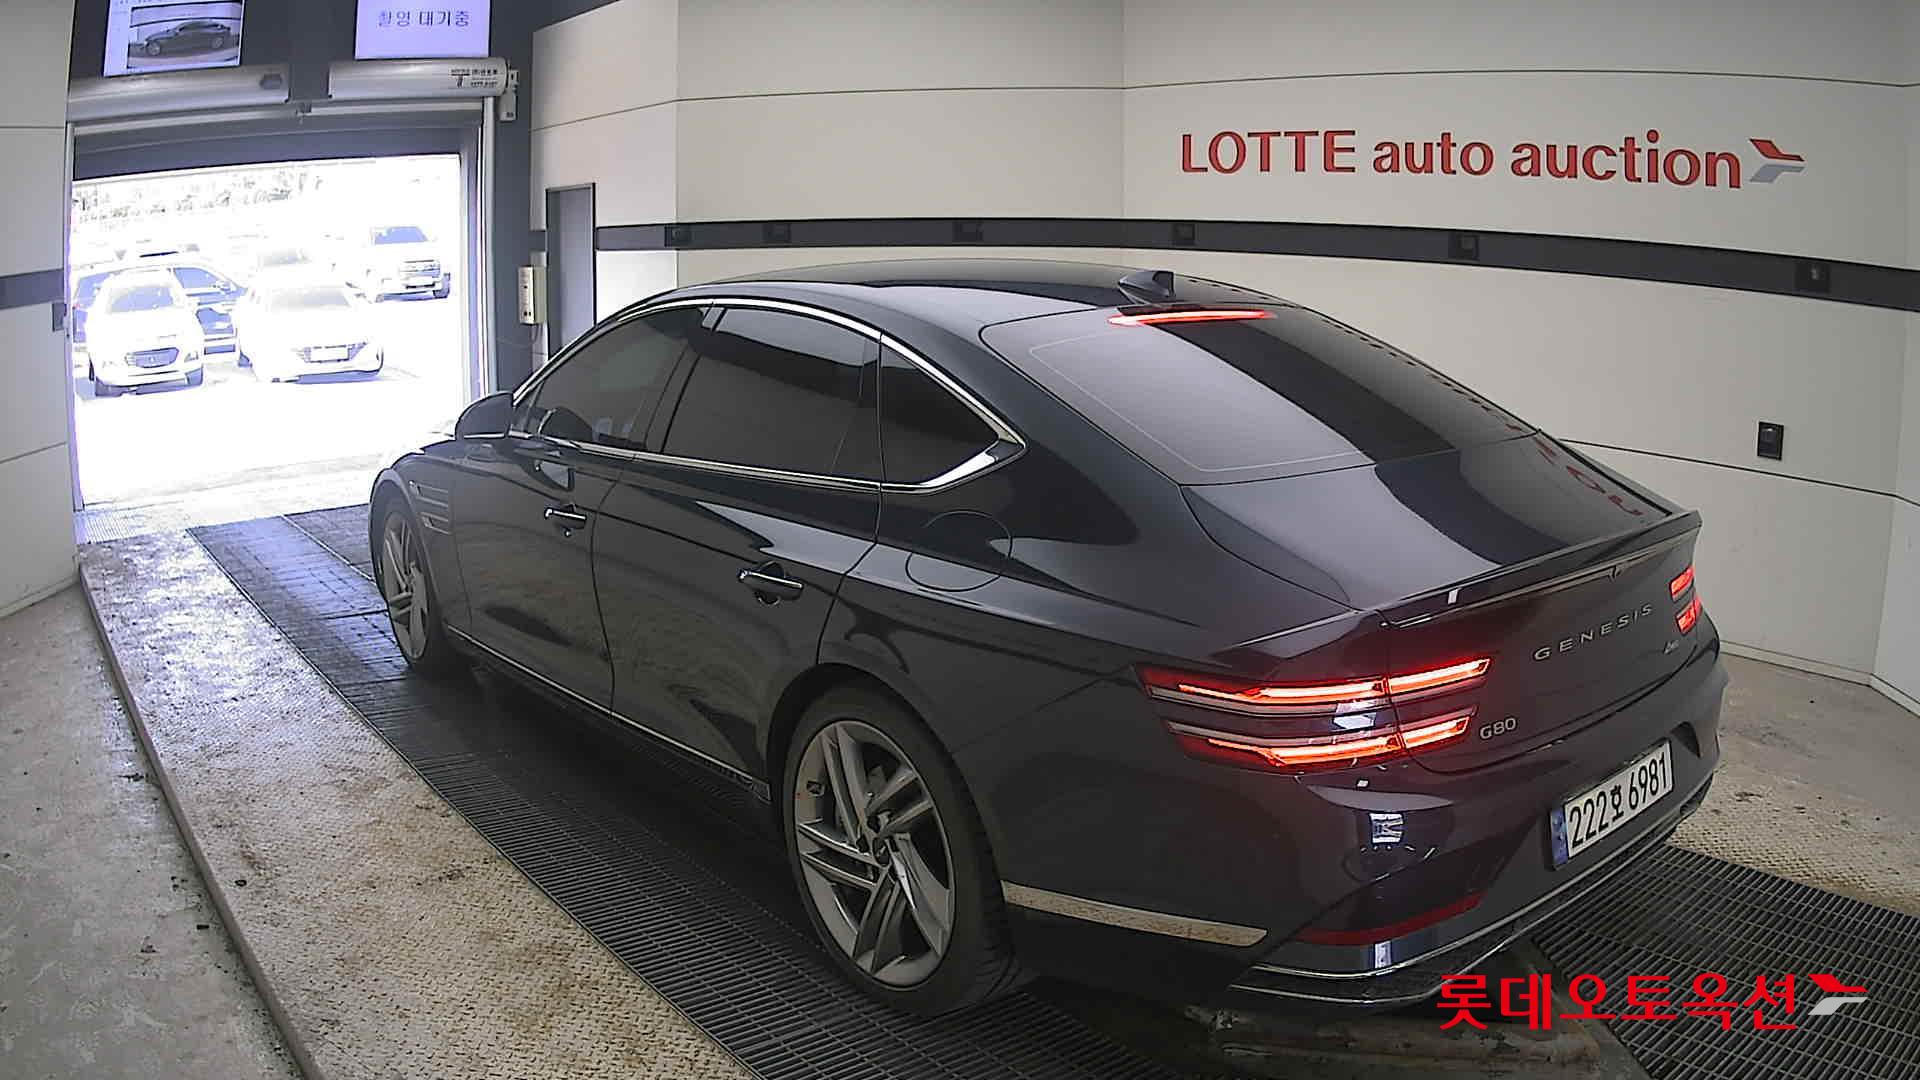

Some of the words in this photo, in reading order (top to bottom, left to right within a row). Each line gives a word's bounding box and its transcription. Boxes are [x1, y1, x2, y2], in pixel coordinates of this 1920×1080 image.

[419, 10, 468, 27] 대기중
[1181, 130, 1356, 173] LOTTE
[1373, 131, 1494, 175] auto
[1511, 130, 1742, 189] auction
[1535, 604, 1653, 660] GENESIS
[1480, 717, 1516, 740] G80
[1628, 751, 1667, 810] 6981
